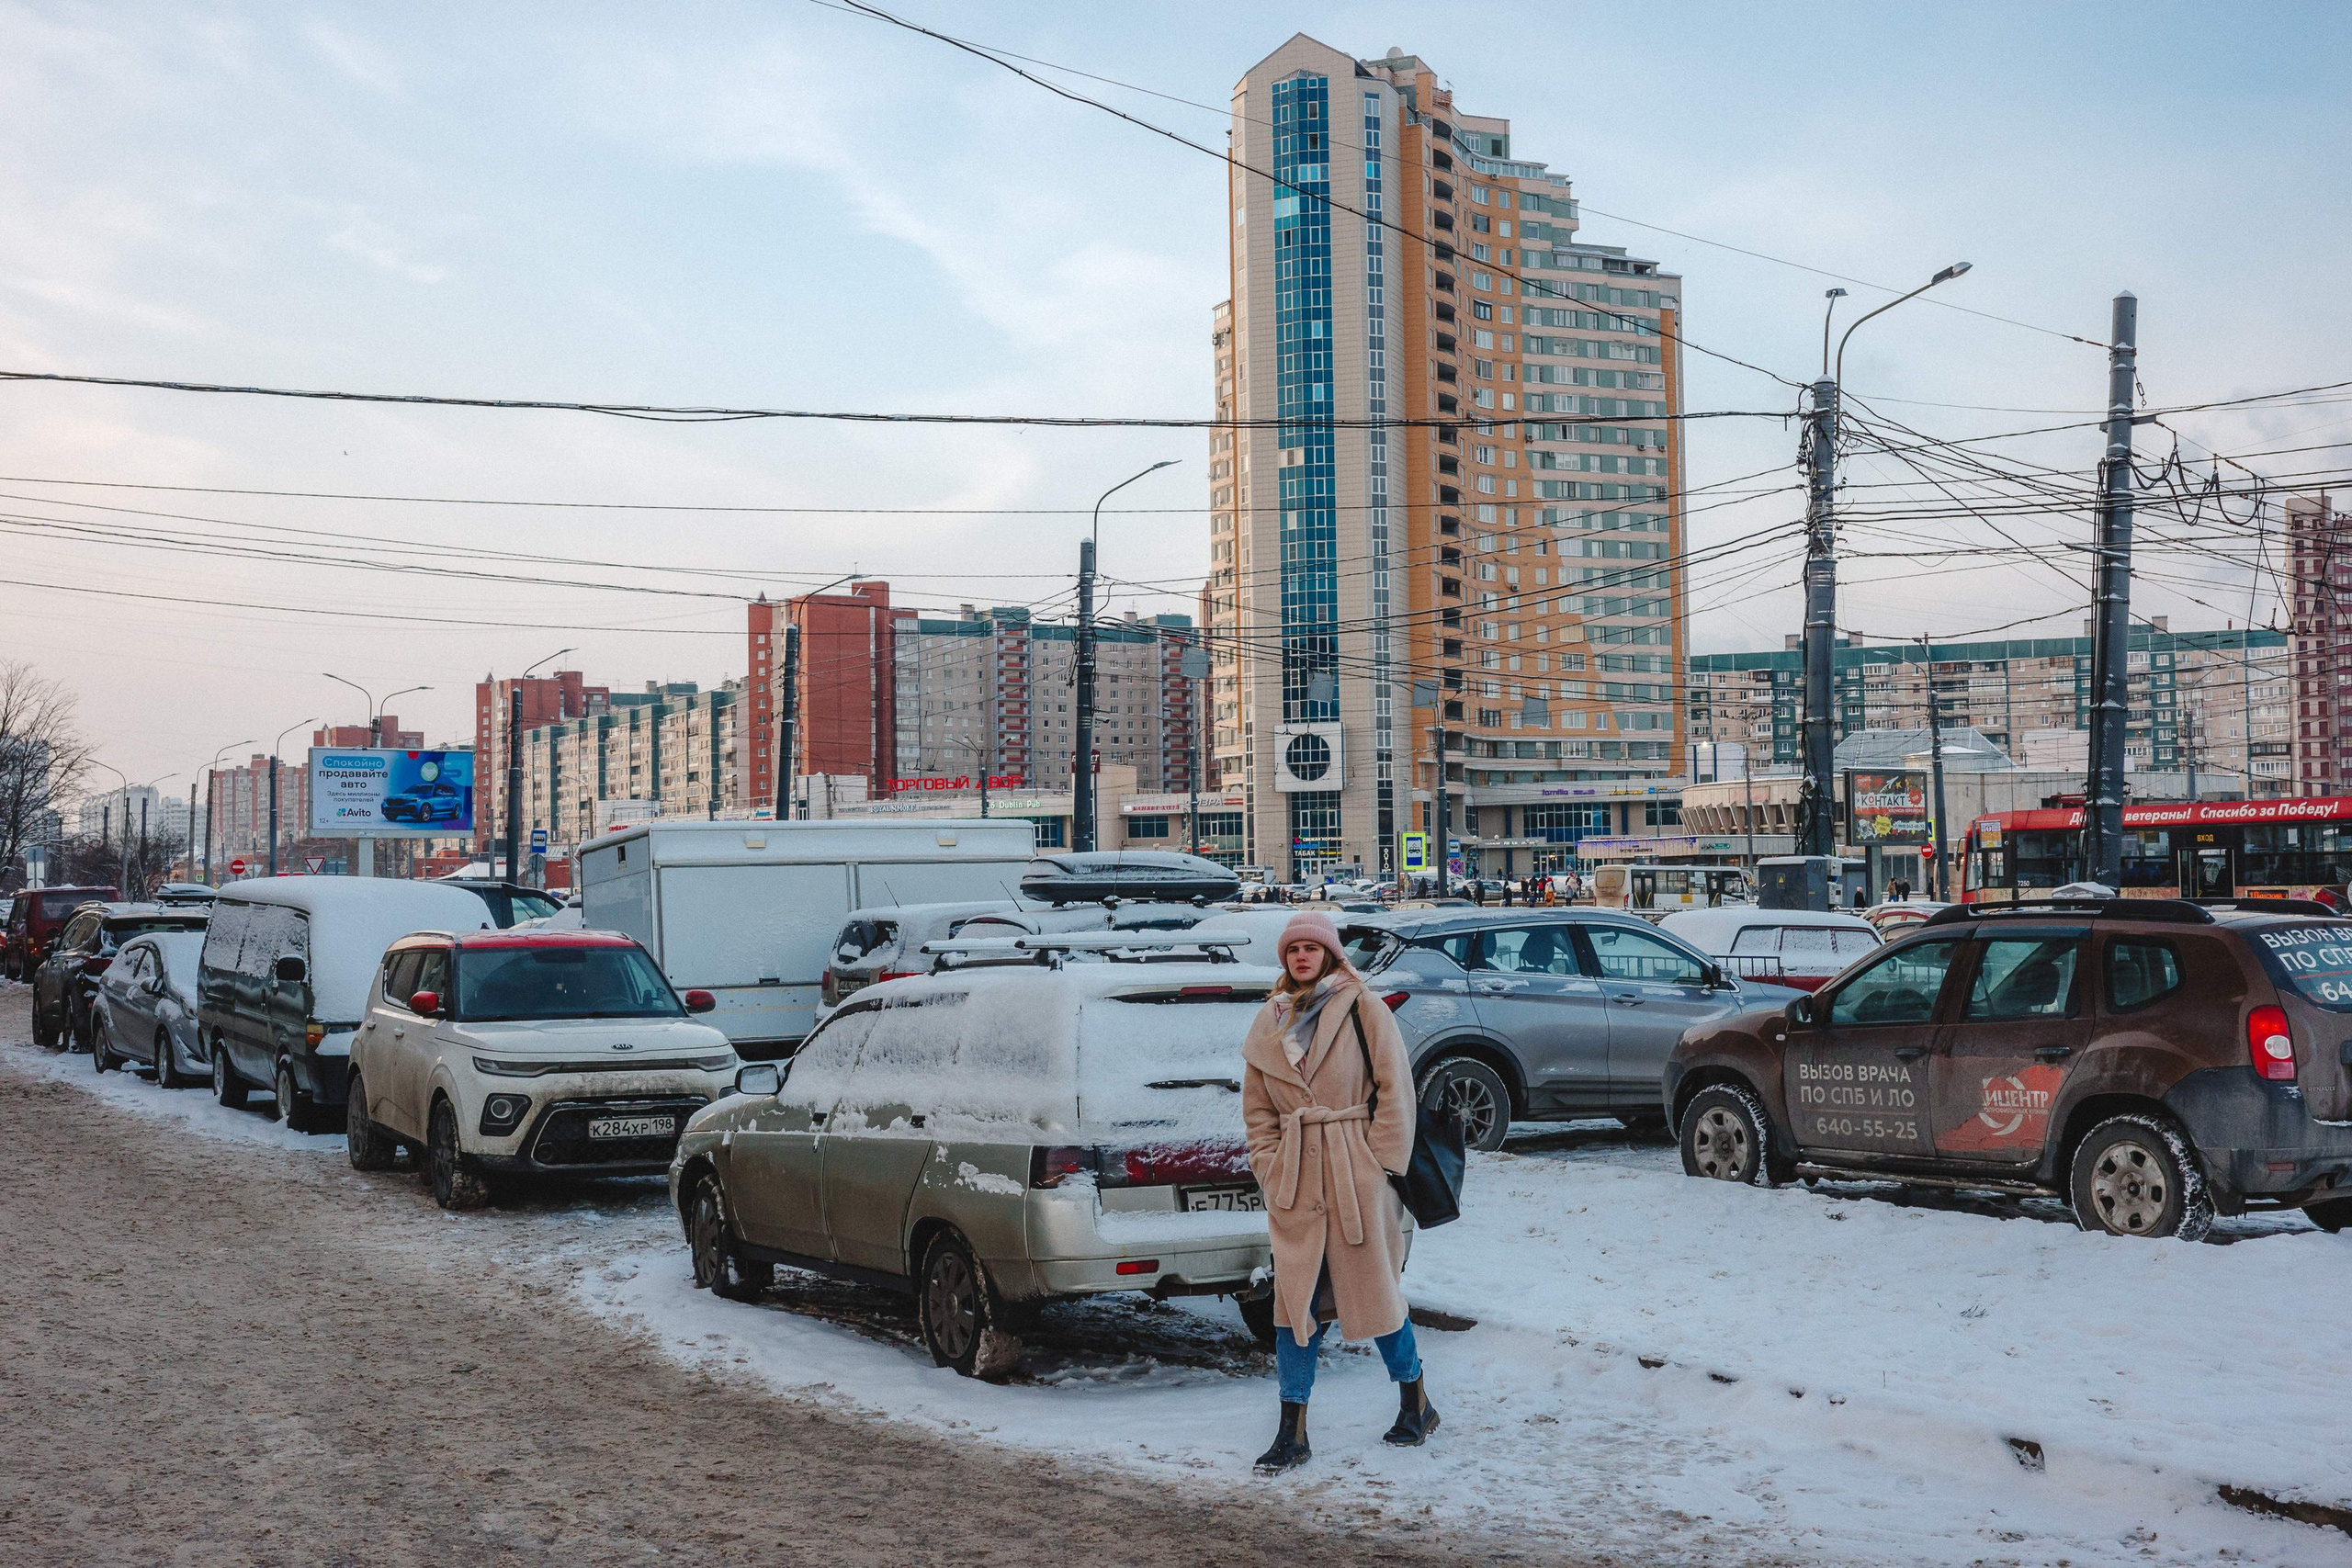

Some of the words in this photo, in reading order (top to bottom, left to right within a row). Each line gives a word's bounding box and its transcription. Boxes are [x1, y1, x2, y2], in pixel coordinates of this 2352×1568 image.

[324, 758, 383, 768] Спокойно
[319, 769, 389, 779] продавайте
[887, 775, 969, 792] ТОРГОВЫЙ
[999, 801, 1023, 809] Dublin
[1027, 800, 1041, 808] Pub
[1861, 795, 1905, 806] КОНТАКТ
[346, 808, 371, 817] Avito
[2124, 807, 2192, 824] ветераны!
[2200, 804, 2257, 818] Спасибо
[2260, 807, 2276, 817] за
[2278, 802, 2338, 818] Победу!
[2197, 834, 2214, 842] ВХОД
[2260, 929, 2335, 949] ВЫЗОВ
[2278, 951, 2316, 971] ПО
[1799, 1064, 1853, 1080] ВЫЗОВ
[1858, 1066, 1911, 1083] ВРАЧА
[1801, 1086, 1826, 1103] ПО
[1831, 1087, 1866, 1105] СПБ
[1871, 1089, 1883, 1106] И
[1888, 1089, 1915, 1108] ЛО
[652, 1118, 673, 1131] 198
[1816, 1117, 1918, 1140] 640-55-25
[1195, 1192, 1267, 1213] Е775Р
